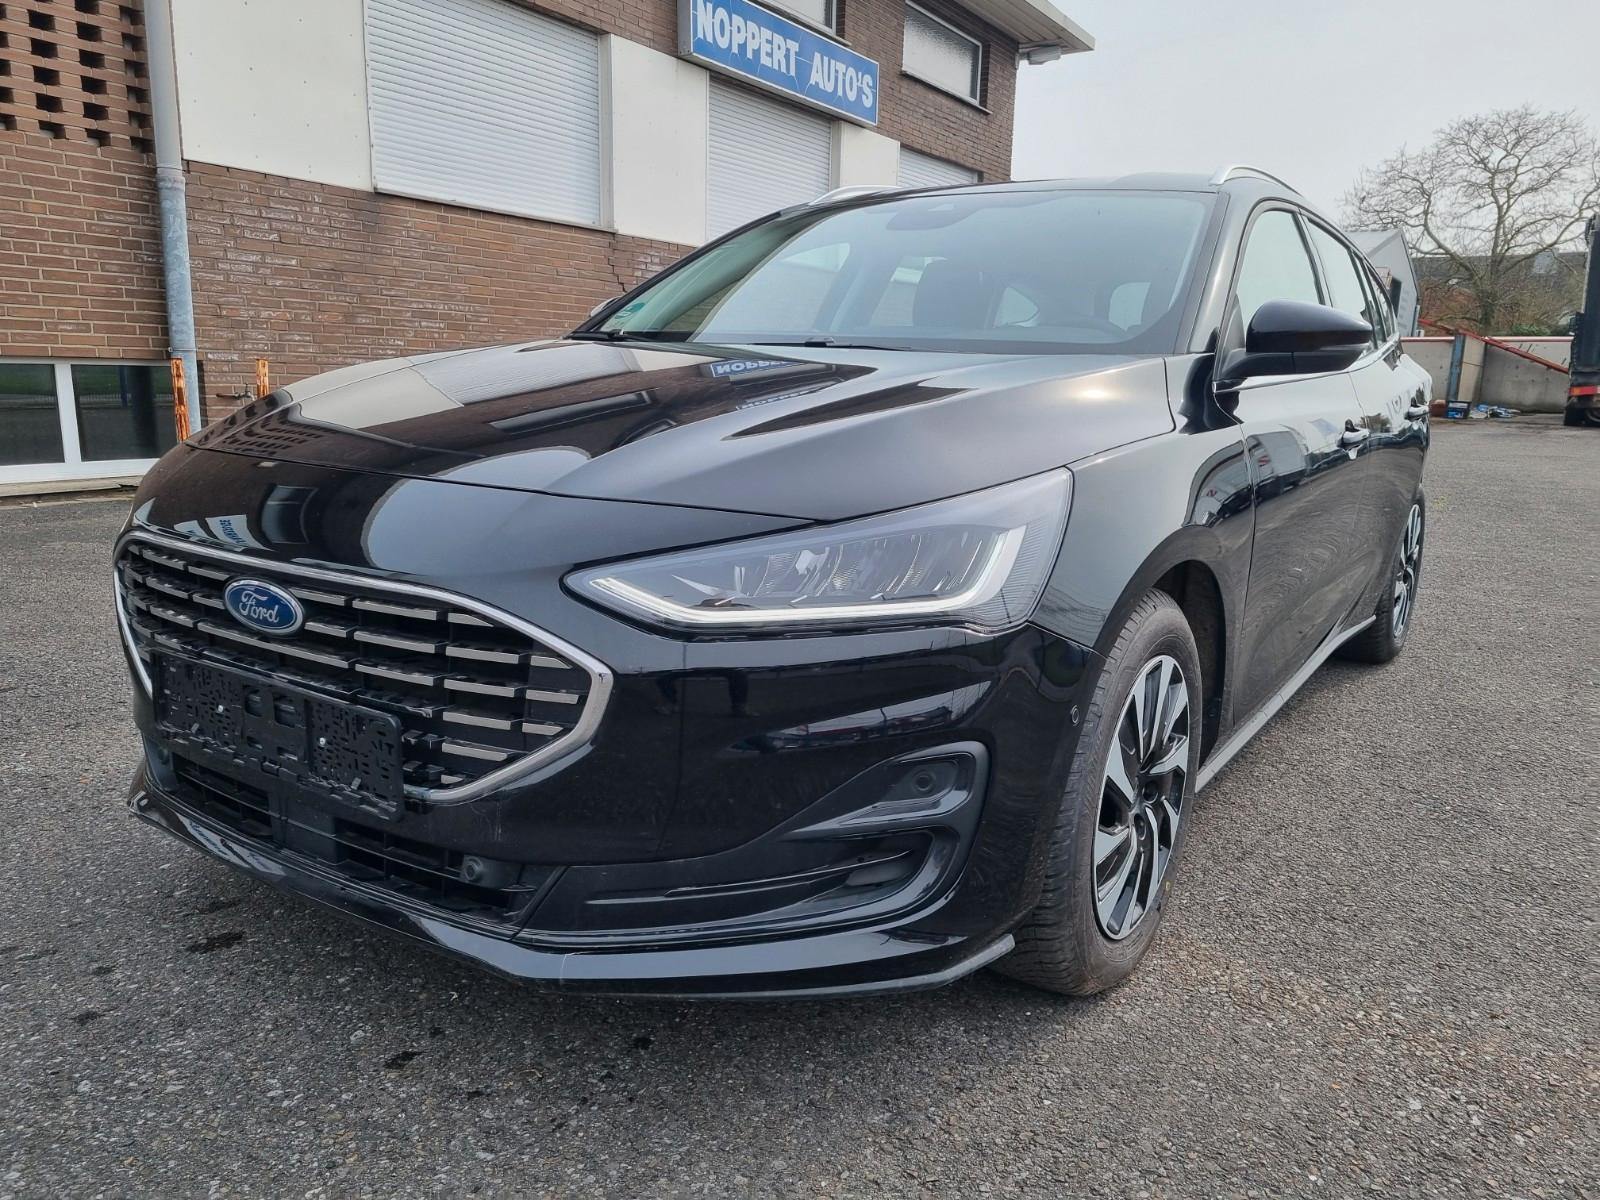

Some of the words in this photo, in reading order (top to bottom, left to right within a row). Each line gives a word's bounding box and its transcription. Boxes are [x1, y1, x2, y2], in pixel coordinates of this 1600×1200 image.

[697, 2, 799, 76] NOPPERT
[810, 51, 873, 109] AUTO'S
[239, 590, 279, 623] Ford
